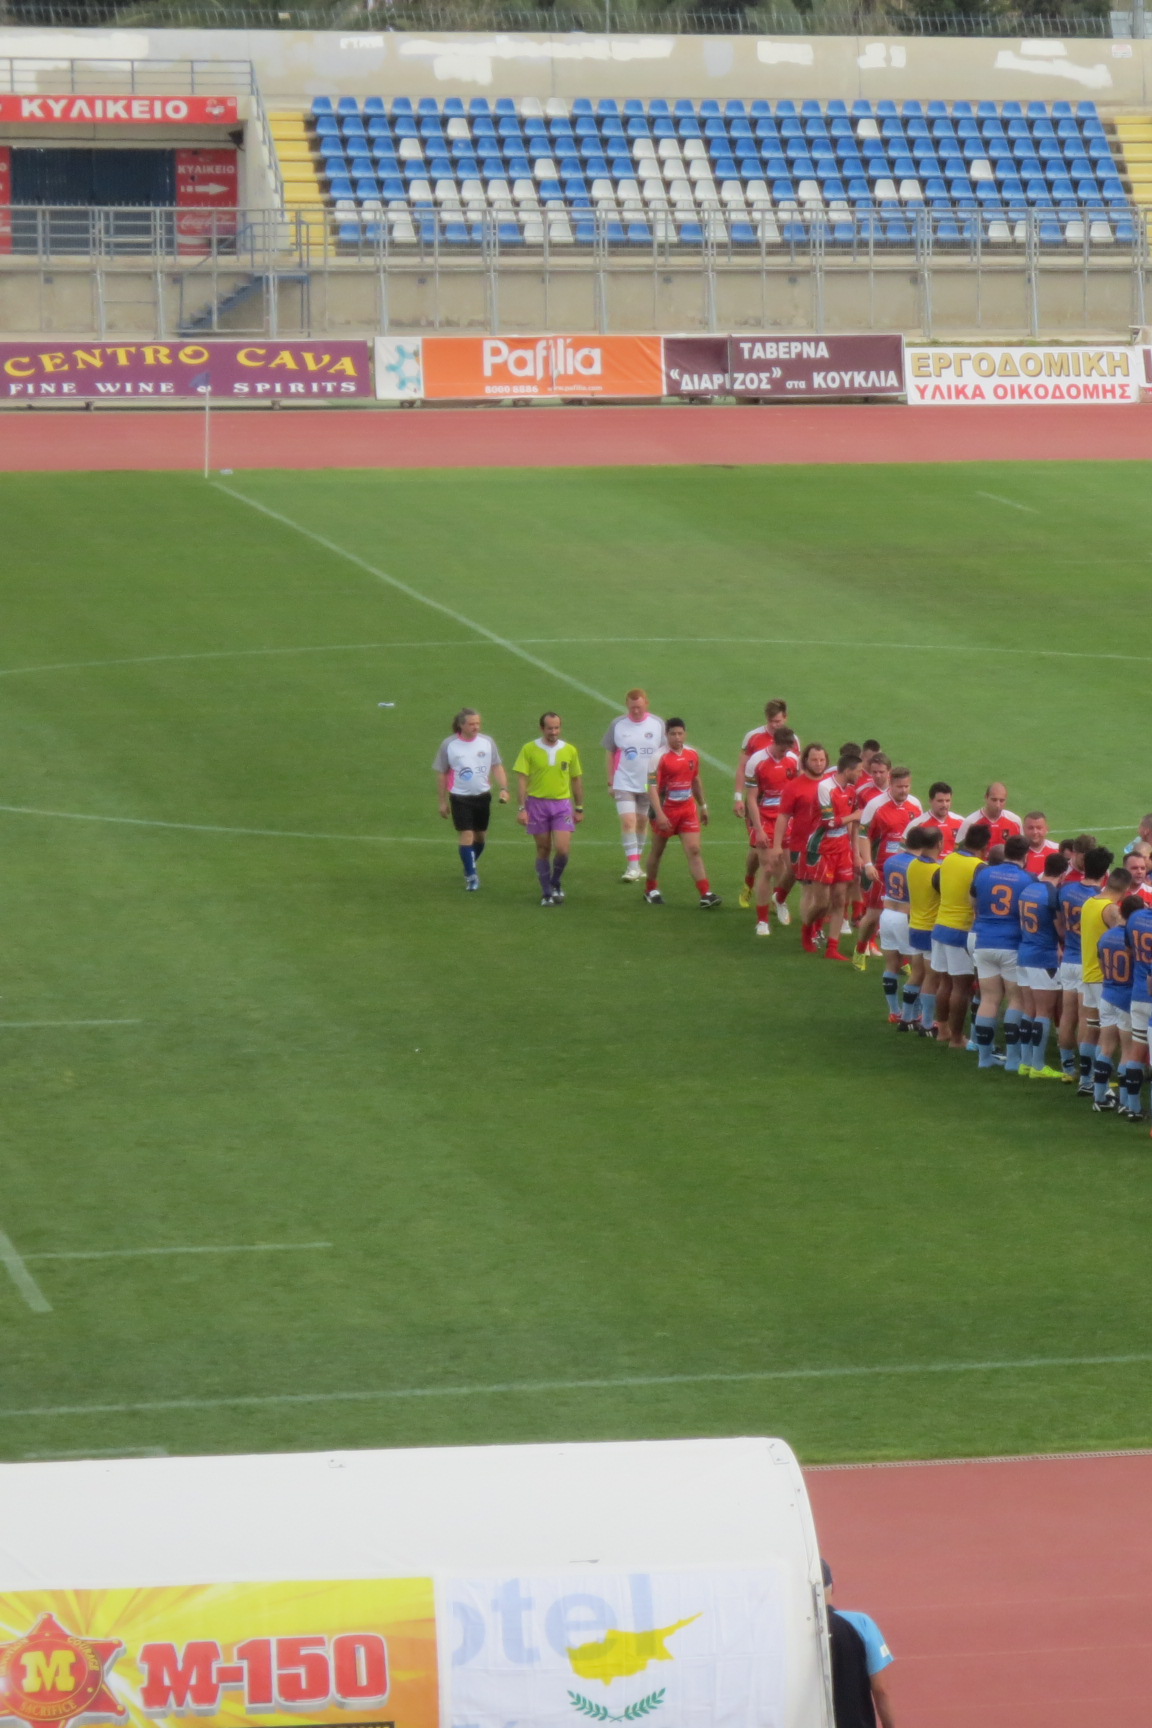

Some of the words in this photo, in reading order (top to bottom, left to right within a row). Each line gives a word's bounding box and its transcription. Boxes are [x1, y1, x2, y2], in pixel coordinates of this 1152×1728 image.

[21, 98, 189, 119] ΚΥΛΙΚΕΙΟ
[178, 165, 235, 174] ΚΥΛΙΚΕΙΟ
[3, 345, 210, 377] CENTRO
[236, 347, 358, 377] CAVA
[483, 338, 602, 381] Pafilia
[740, 341, 829, 359] ΤΑΒΕΡΝΑ
[911, 352, 1130, 377] ΕΡΓΟΔΟΜΙΚΗ
[9, 383, 77, 396] FINE
[95, 382, 175, 393] WINE
[233, 382, 357, 394] SPIRITS
[785, 380, 806, 389] στα
[813, 371, 899, 389] ΚΟΥΚΛΙΑ
[914, 384, 986, 399] ΥΛΙΚΑ
[992, 384, 1132, 399] ΟΙΚΟΔΟΜΗΣ
[990, 885, 1013, 916] 3
[1019, 900, 1038, 933] 15
[1103, 948, 1131, 983] 10
[67, 1636, 100, 1671] COURAGE
[20, 1649, 77, 1693] M
[138, 1633, 391, 1718] M-150
[20, 1700, 77, 1716] SACRIFICE
